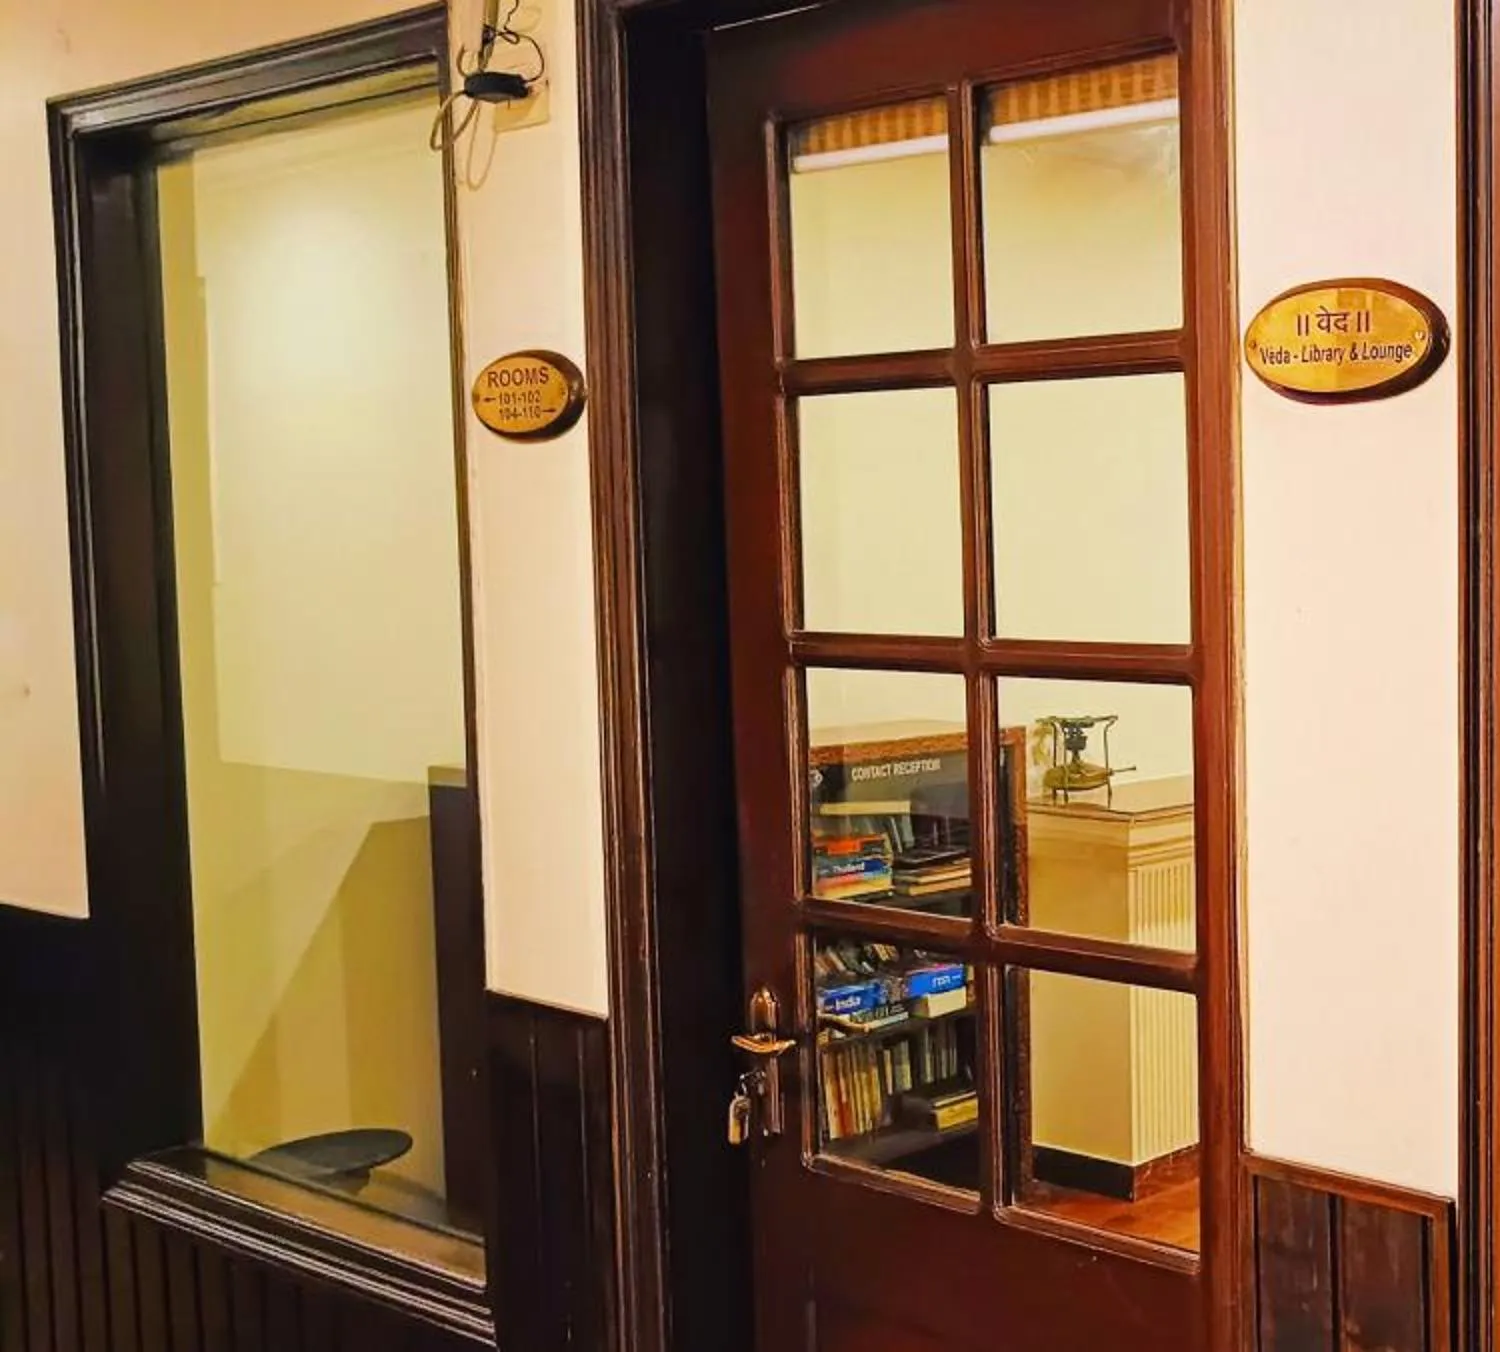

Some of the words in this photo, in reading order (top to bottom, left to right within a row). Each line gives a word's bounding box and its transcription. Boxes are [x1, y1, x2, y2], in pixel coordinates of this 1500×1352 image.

[1316, 306, 1350, 333] वेद
[1261, 347, 1291, 366] Veda
[1302, 345, 1345, 366] Library
[1349, 342, 1360, 362] &
[1362, 342, 1413, 364] Lounge
[487, 366, 549, 388] ROOMS
[851, 764, 891, 781] CONTACT
[893, 758, 940, 775] RECEPTION
